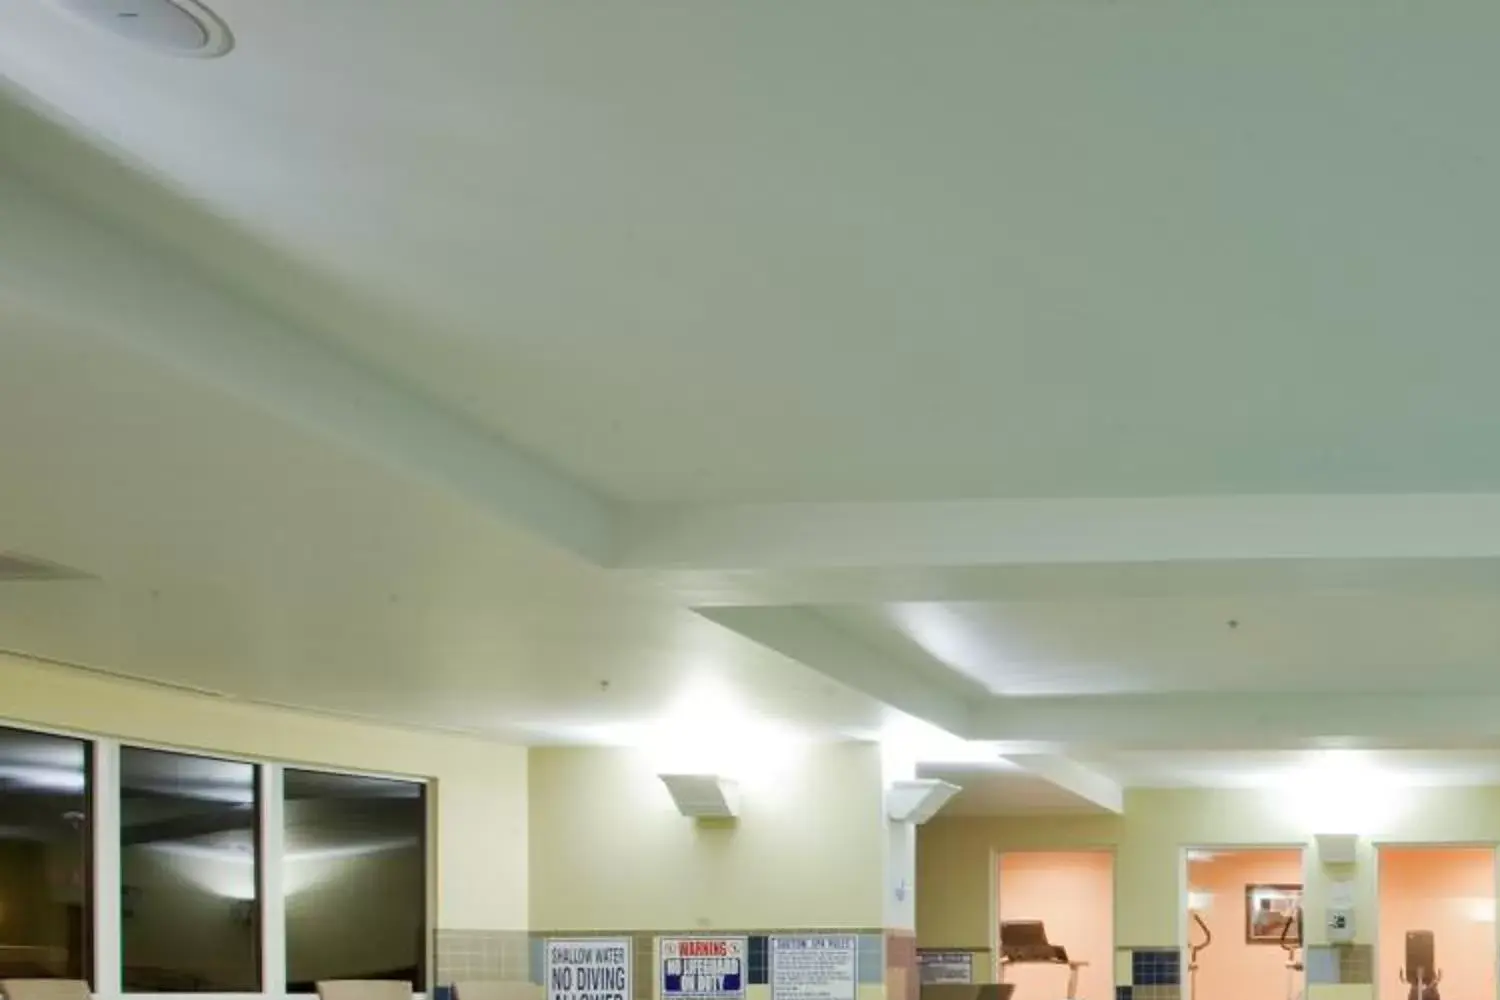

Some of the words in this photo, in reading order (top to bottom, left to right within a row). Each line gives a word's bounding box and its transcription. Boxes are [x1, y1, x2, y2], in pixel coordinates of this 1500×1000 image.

[551, 947, 593, 965] SHALLOW
[594, 947, 625, 964] WATER
[677, 941, 727, 957] WARNING
[552, 967, 572, 991] NO
[577, 966, 625, 991] DIVING
